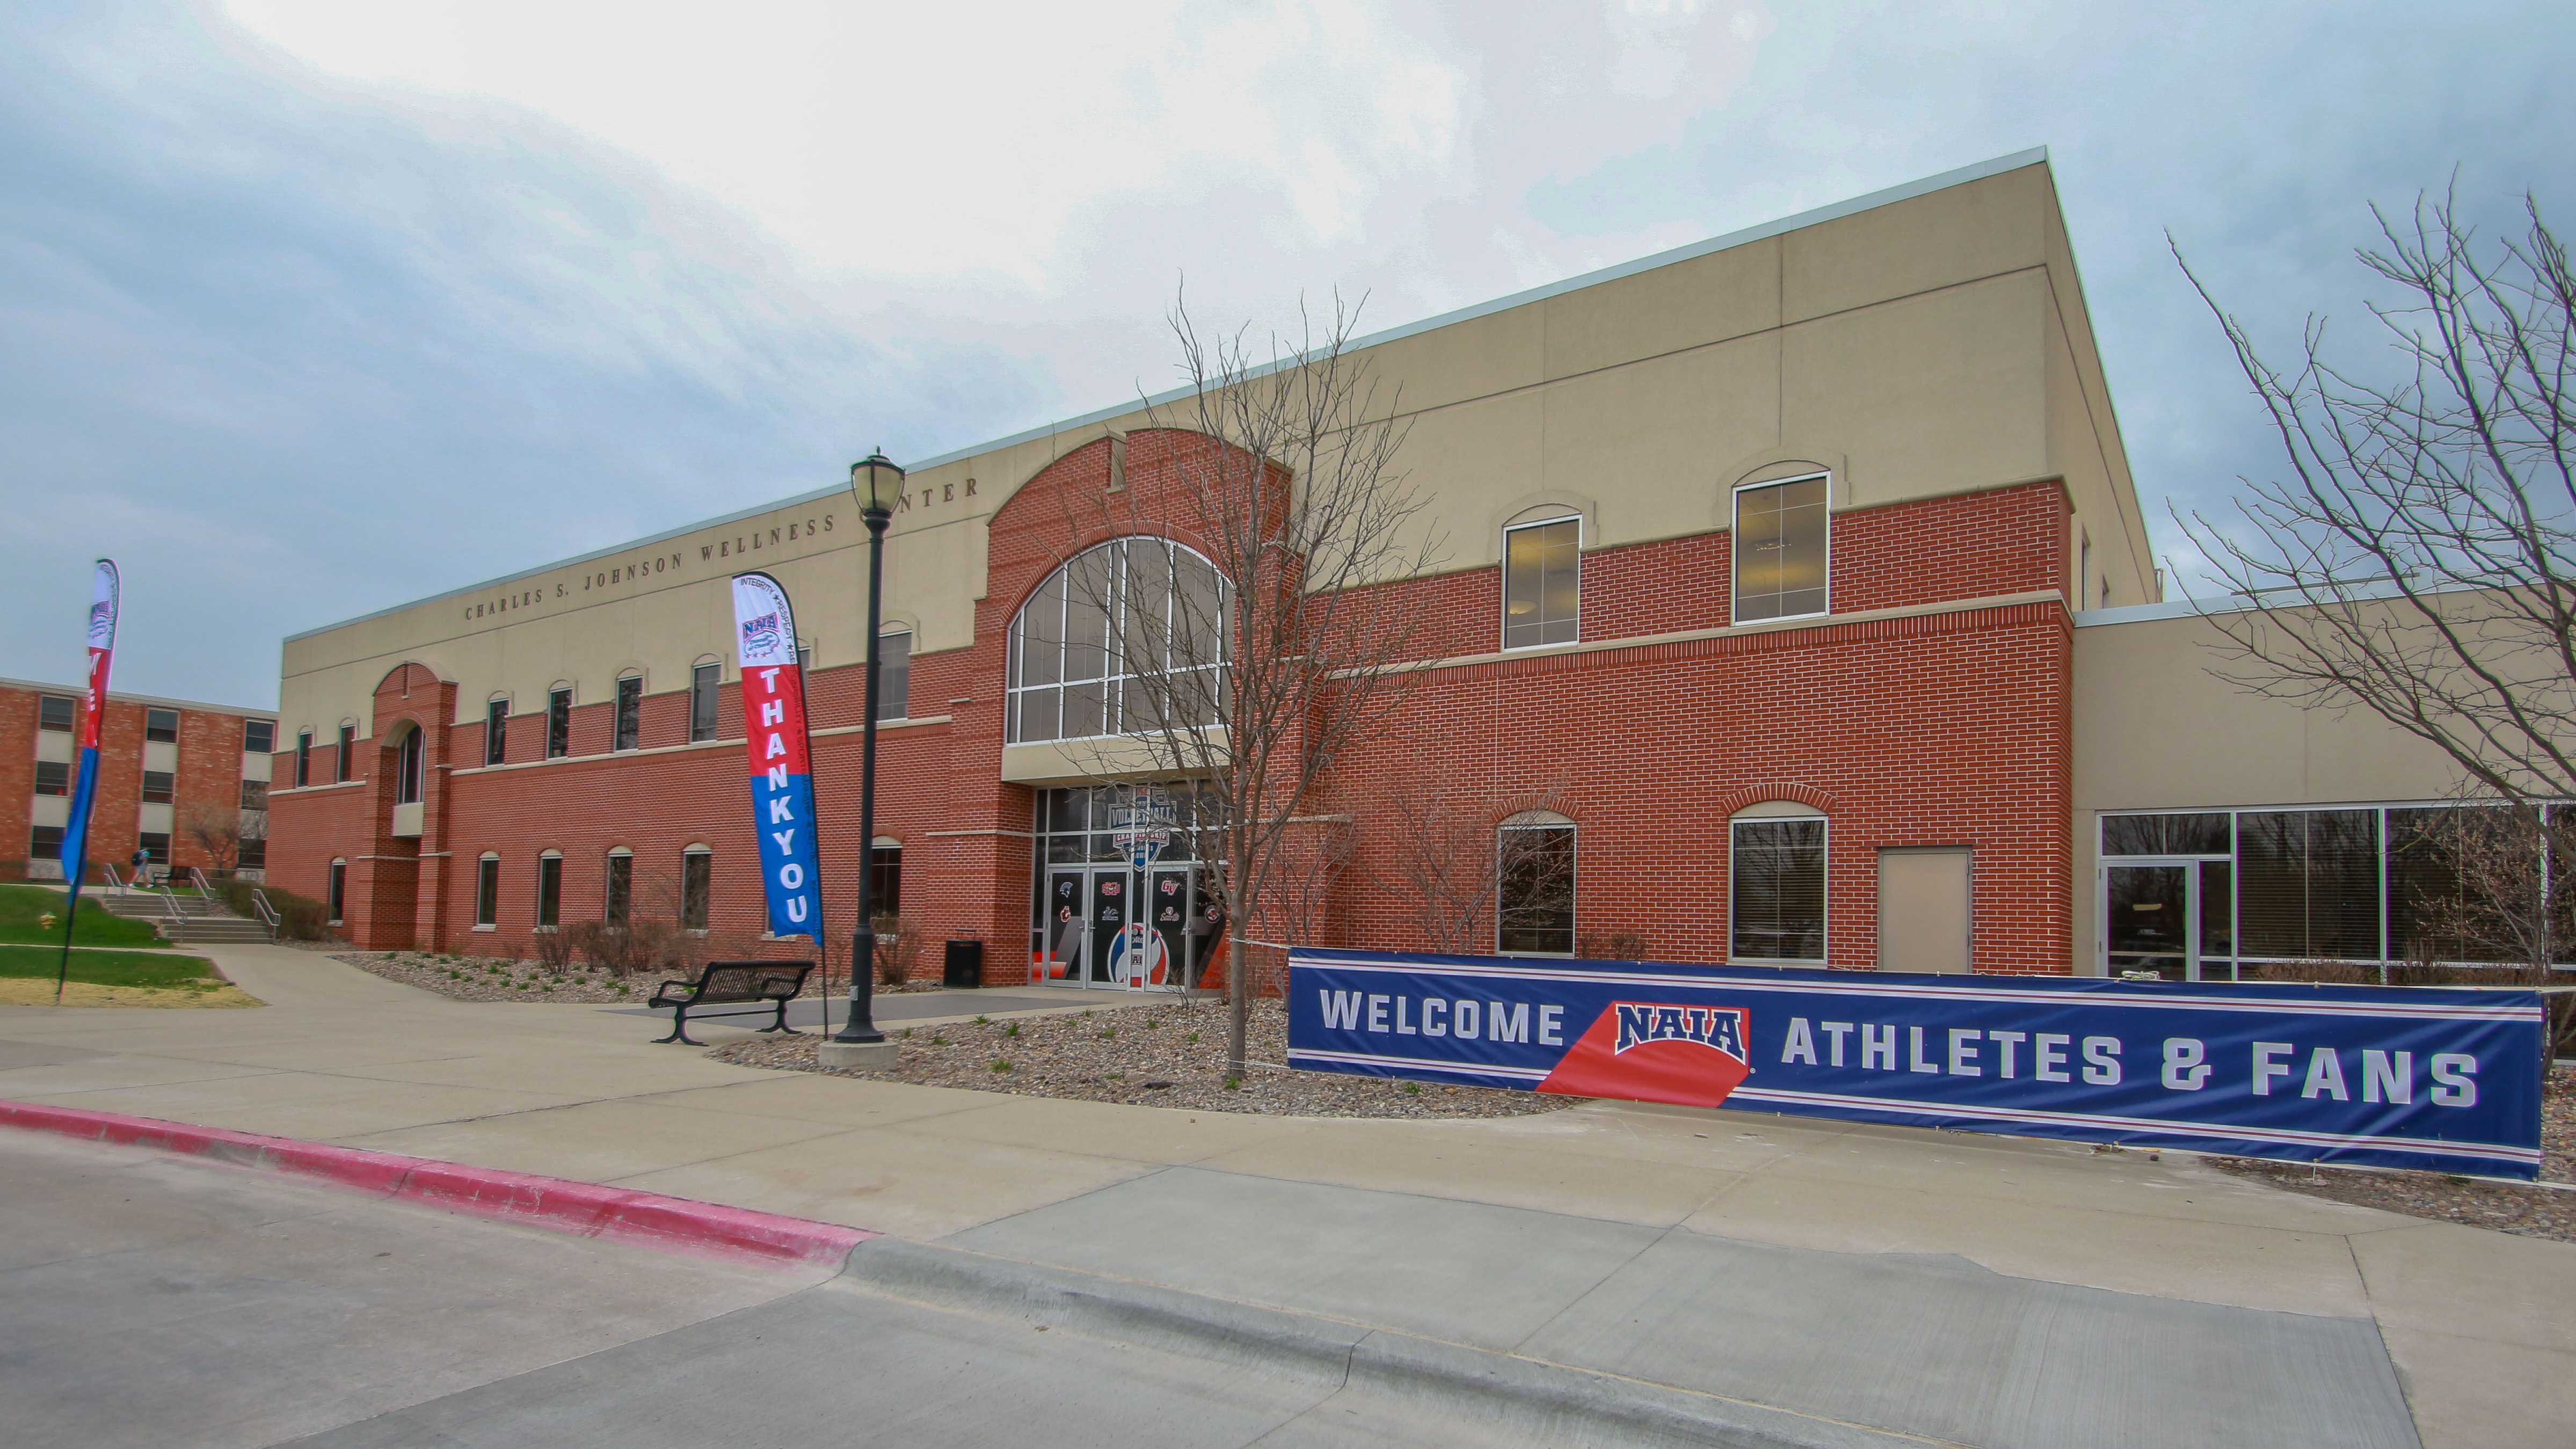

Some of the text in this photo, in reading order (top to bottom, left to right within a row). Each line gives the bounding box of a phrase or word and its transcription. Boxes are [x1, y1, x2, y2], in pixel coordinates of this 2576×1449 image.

[465, 477, 978, 621] CHARLES S. JOHNSON WELLNESS NTER
[740, 577, 776, 596] INTEGRITY
[743, 614, 778, 640] NAIA
[777, 600, 793, 640] RESPECT
[1319, 988, 2478, 1108] WELCOME NAIA ATHLETES & FANS
